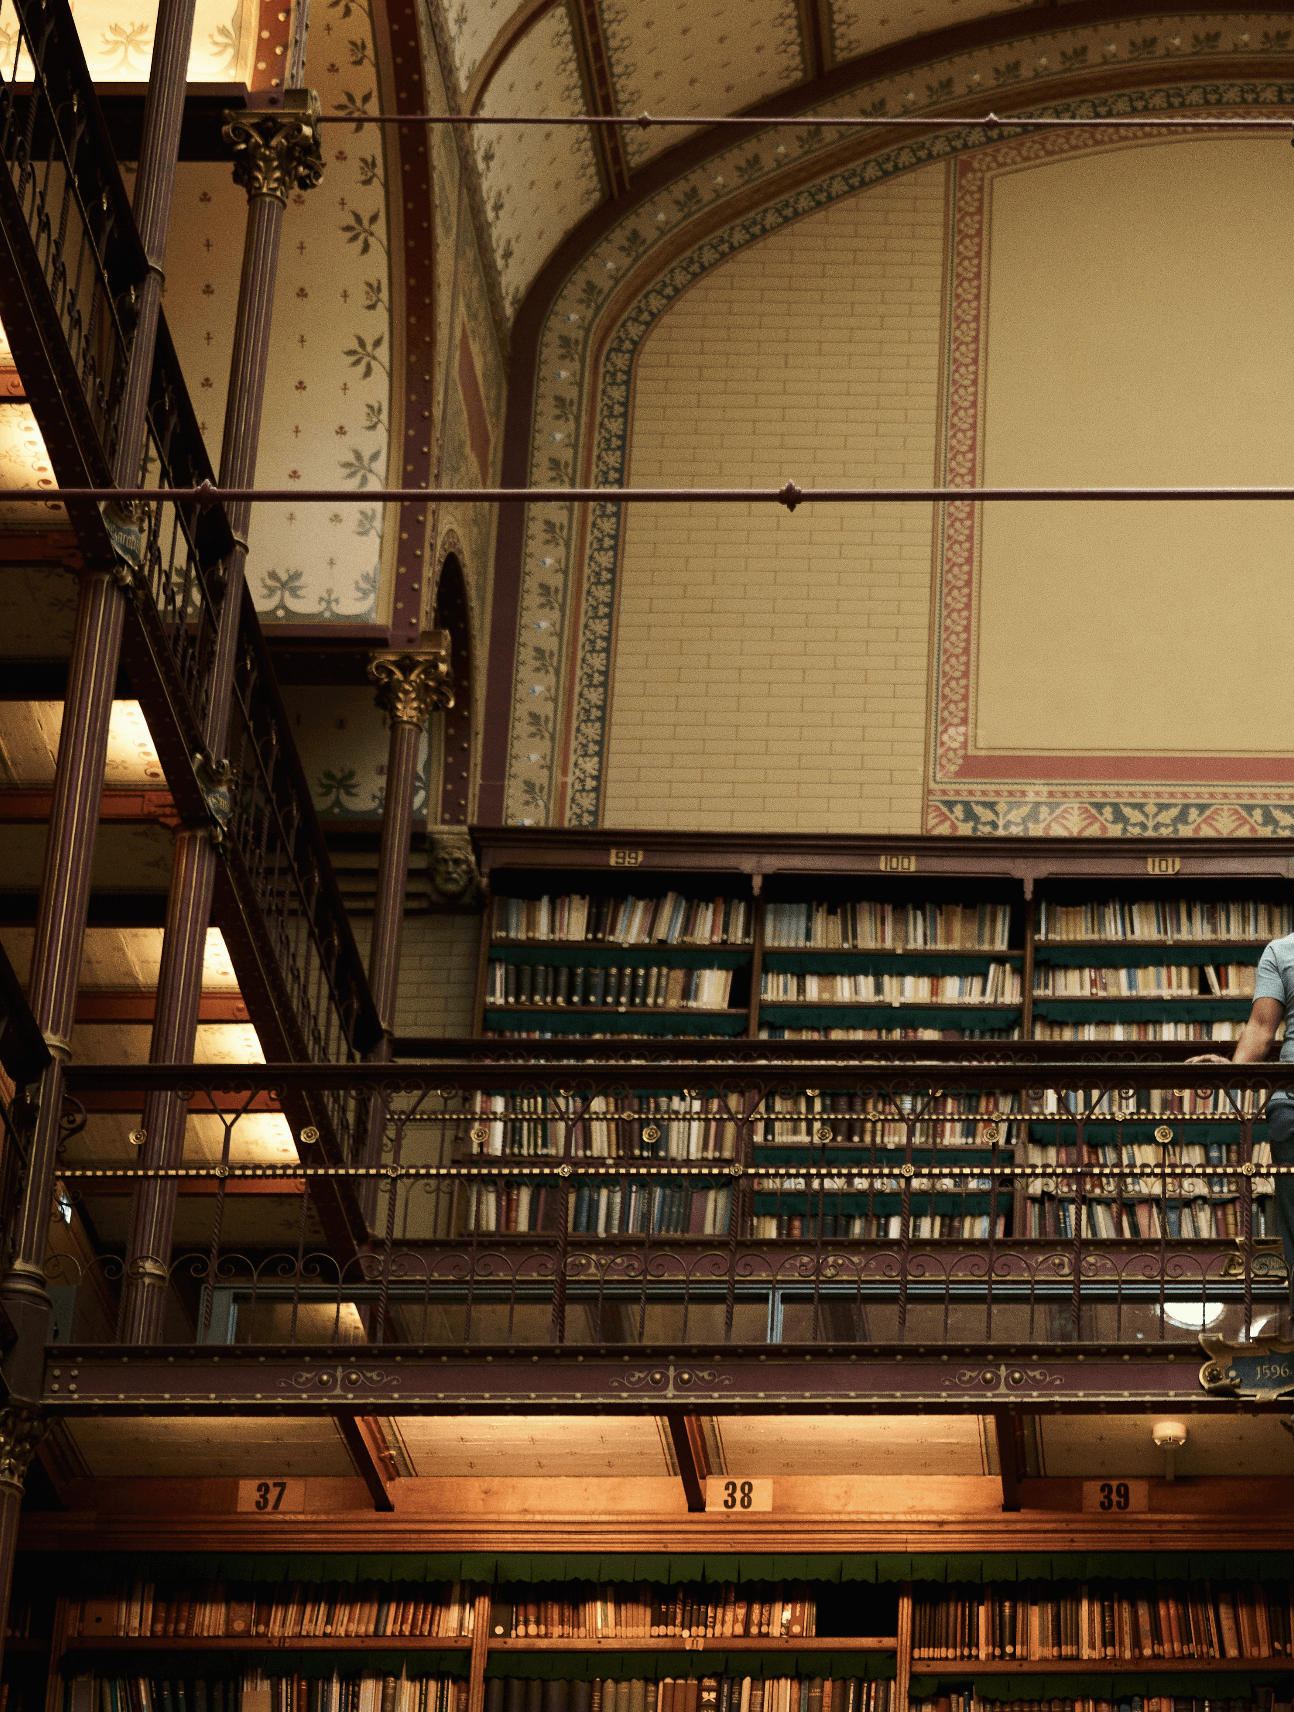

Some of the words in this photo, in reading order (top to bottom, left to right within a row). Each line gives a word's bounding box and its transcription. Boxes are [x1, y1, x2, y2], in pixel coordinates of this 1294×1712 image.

[615, 850, 639, 865] 99
[884, 856, 911, 870] 100
[1152, 858, 1175, 872] 101
[255, 1481, 287, 1511] 37
[723, 1480, 753, 1510] 38
[1100, 1482, 1130, 1511] 39
